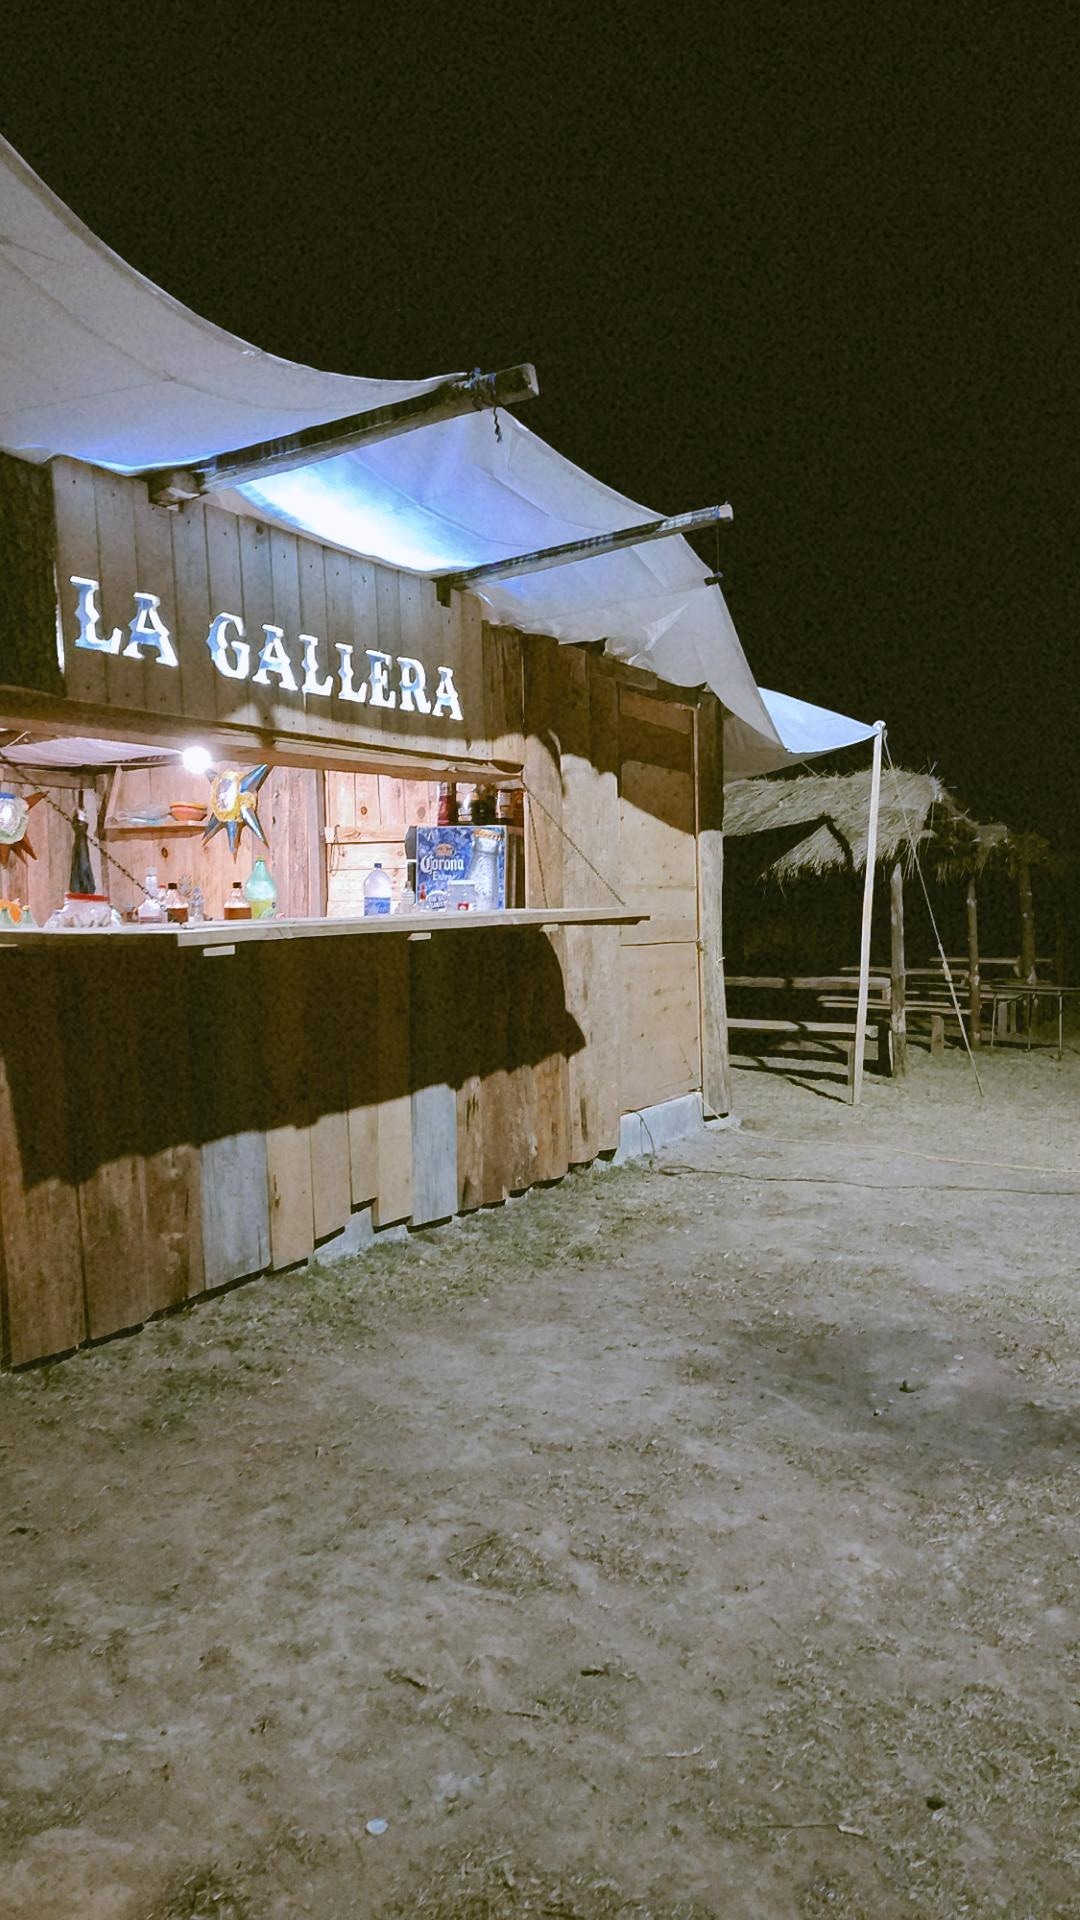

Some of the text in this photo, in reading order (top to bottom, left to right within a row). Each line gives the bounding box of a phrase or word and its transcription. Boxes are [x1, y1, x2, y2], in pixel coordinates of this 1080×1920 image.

[69, 576, 464, 721] LA GALLERA
[420, 855, 464, 874] Corona
